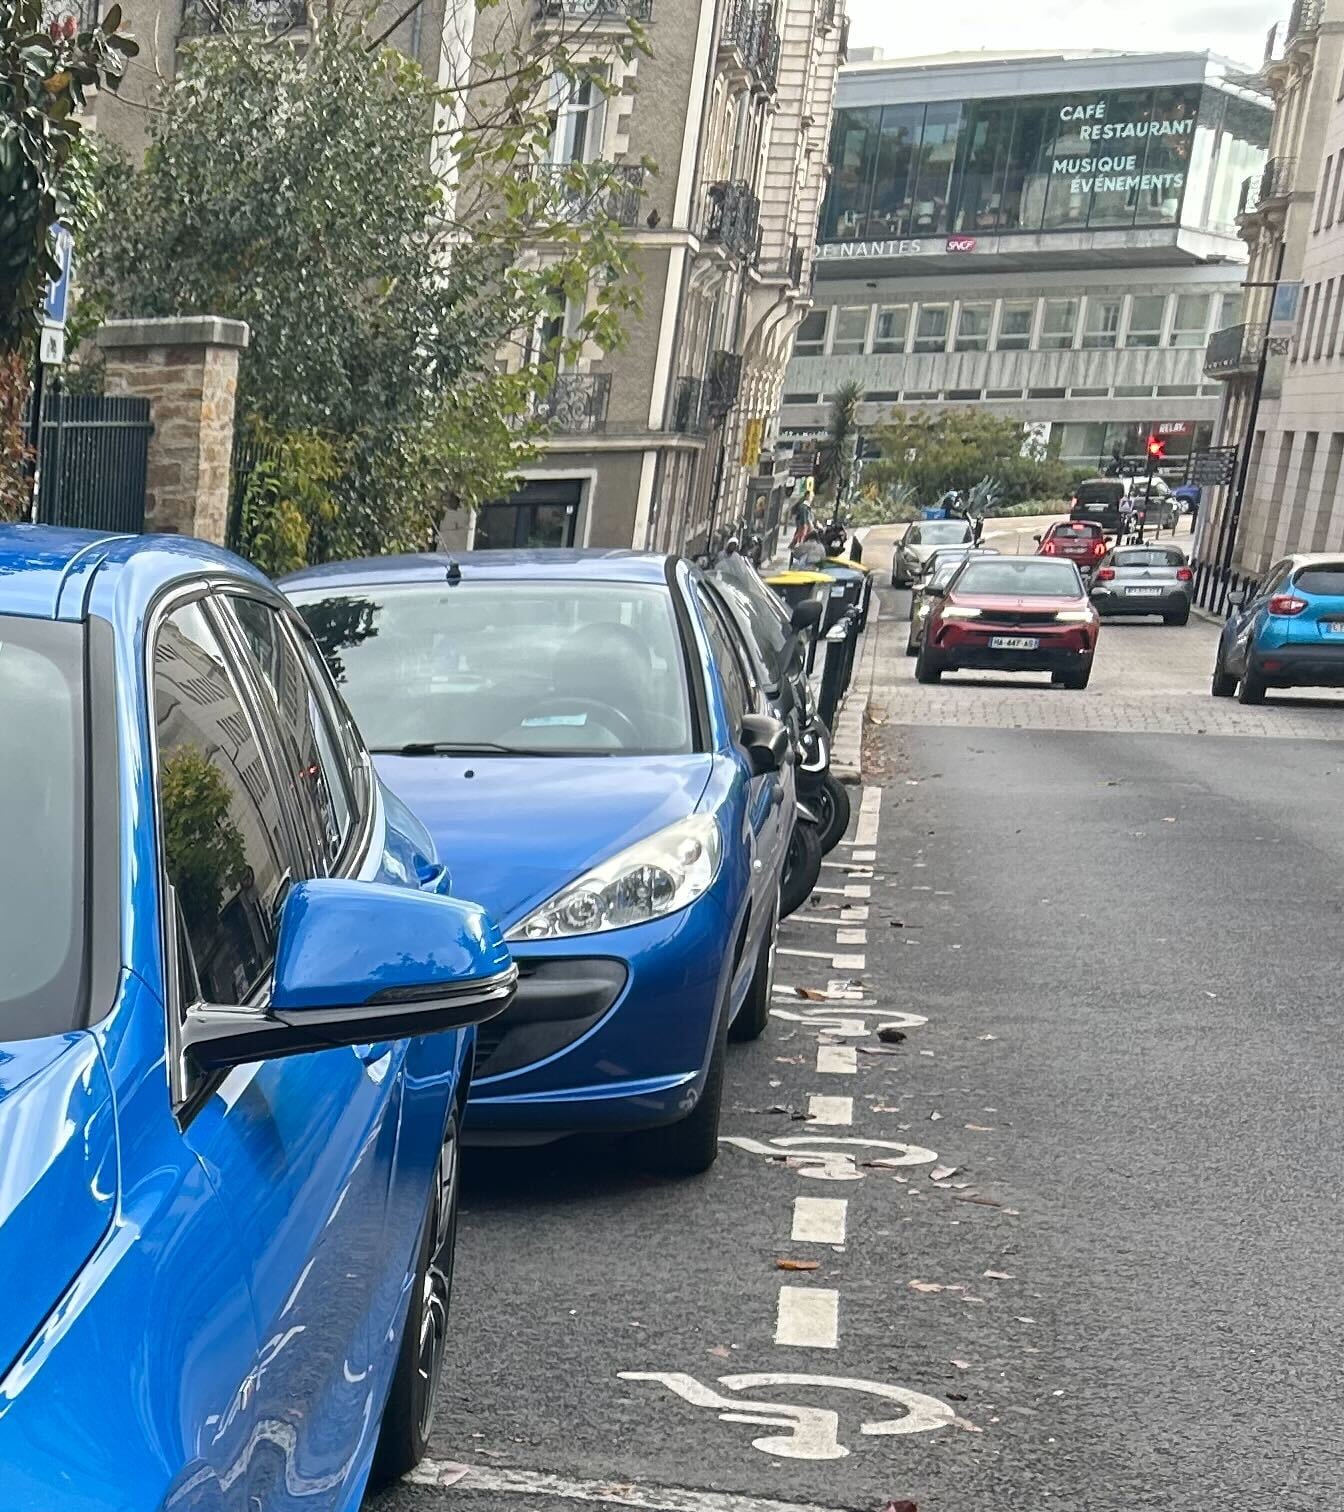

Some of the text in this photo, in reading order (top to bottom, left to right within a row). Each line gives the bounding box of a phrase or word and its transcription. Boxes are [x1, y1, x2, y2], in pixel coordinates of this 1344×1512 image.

[1059, 101, 1106, 121] CAFÉ
[1080, 119, 1194, 140] RESTAURANT
[1052, 155, 1137, 174] MUSIQUE
[1070, 173, 1184, 194] ÉVÉNEMENTS
[840, 239, 921, 257] NANTES
[947, 240, 975, 251] SNCF
